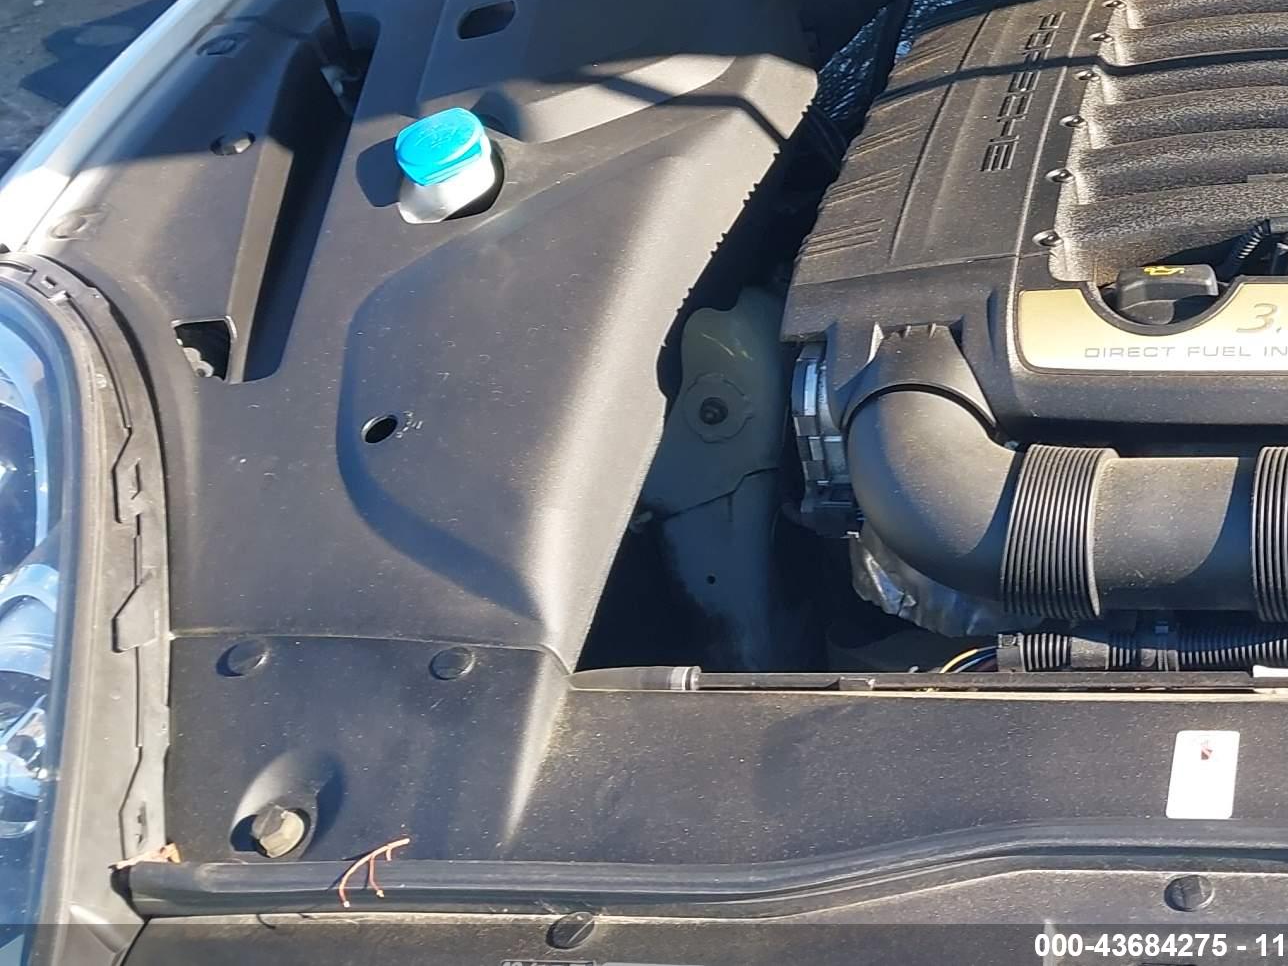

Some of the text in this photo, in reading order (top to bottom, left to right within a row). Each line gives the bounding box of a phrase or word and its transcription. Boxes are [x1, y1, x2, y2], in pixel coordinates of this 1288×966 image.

[979, 11, 1067, 172] PORSCHE
[1084, 345, 1176, 359] DIRECT
[1187, 345, 1251, 358] FUEL
